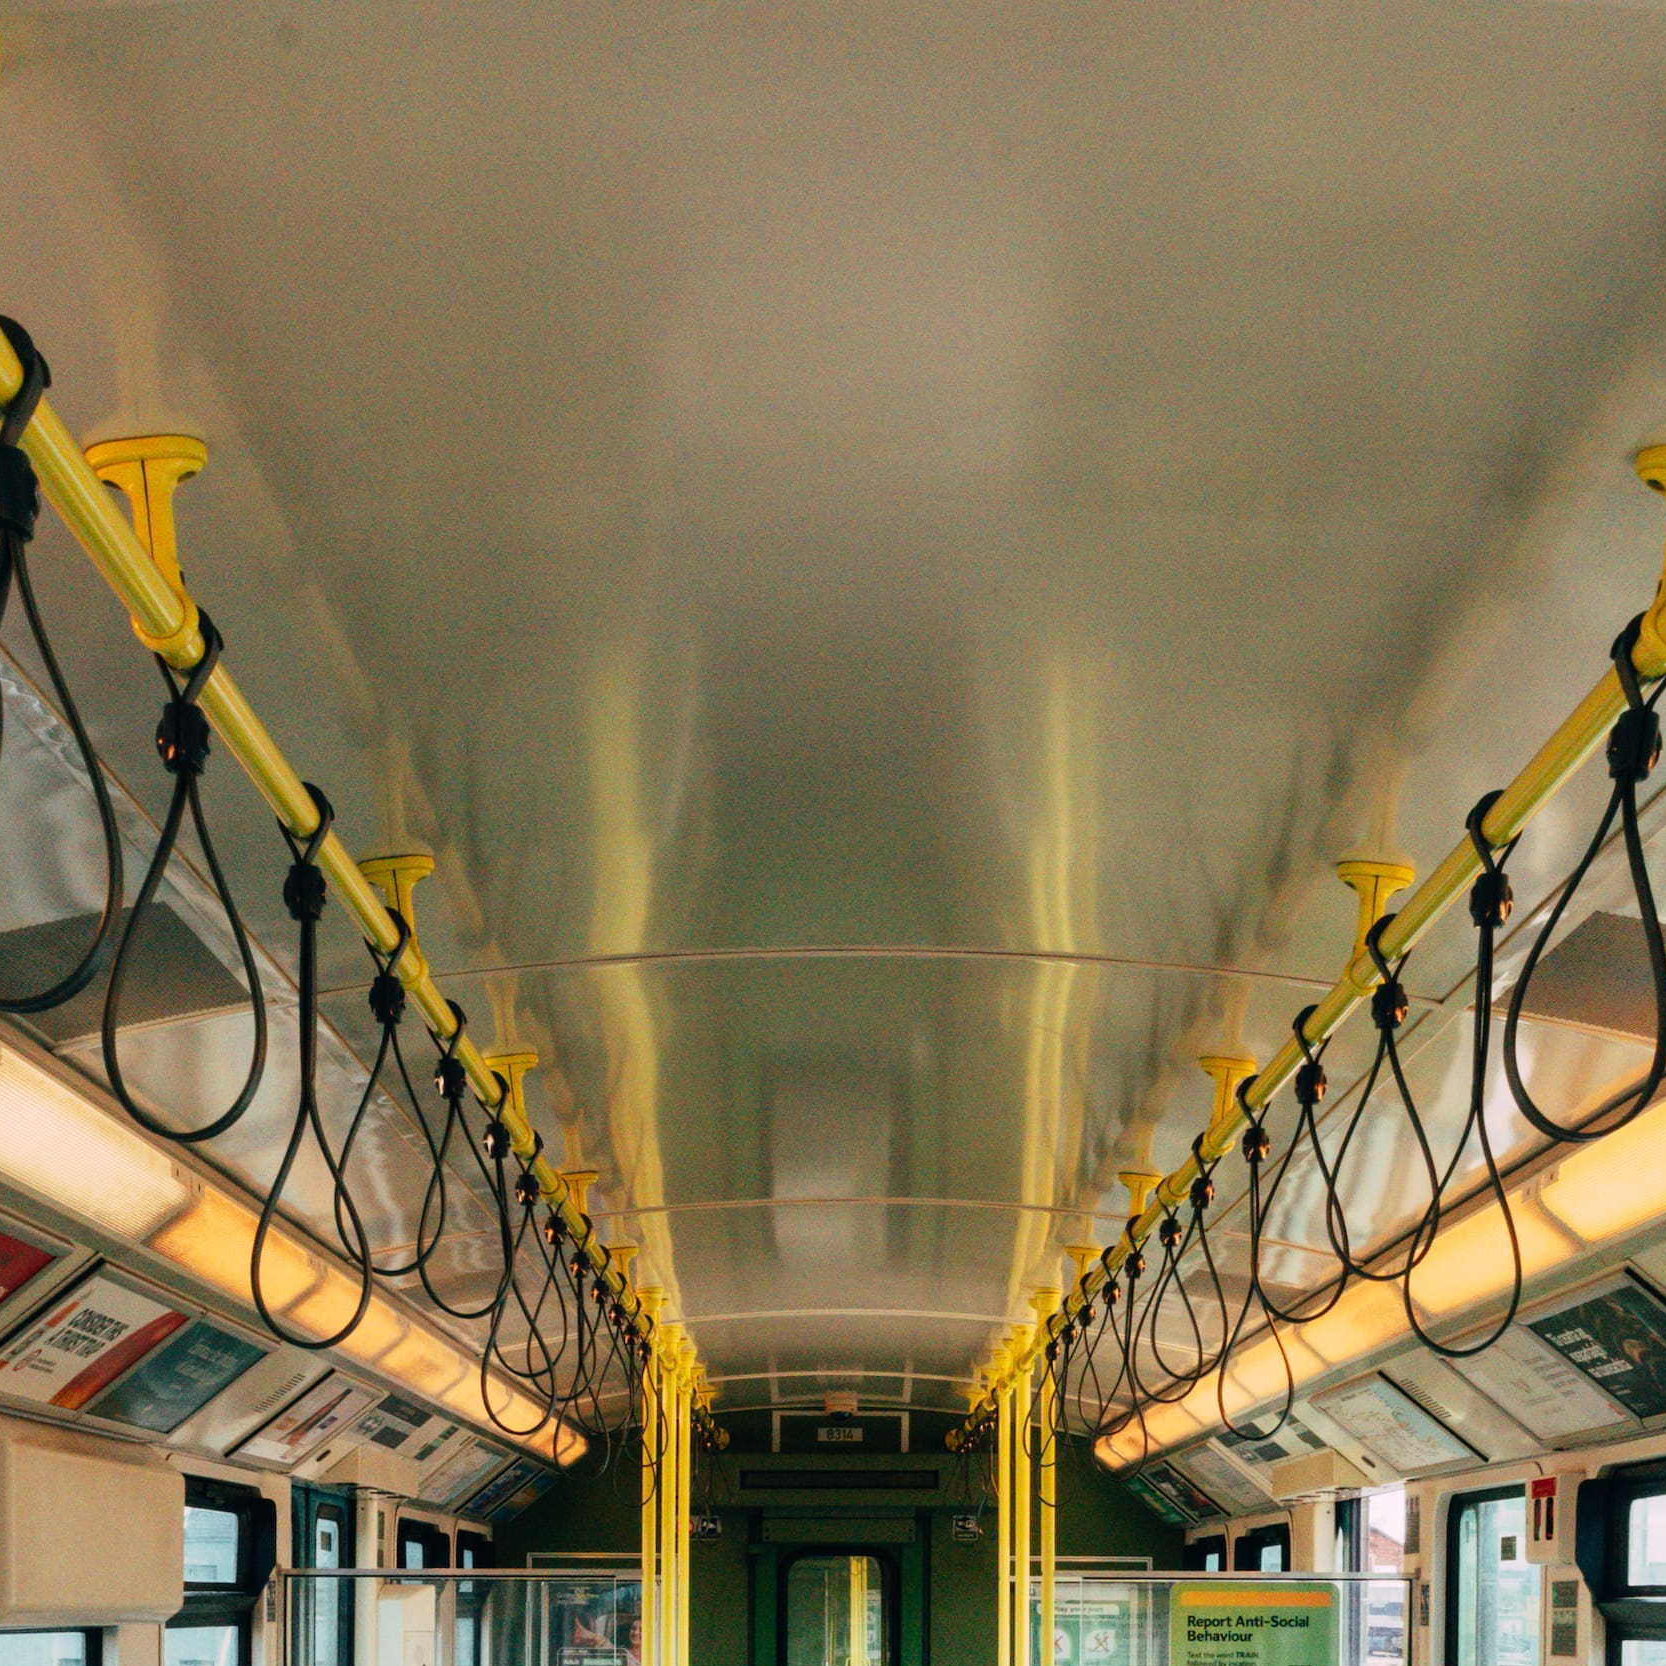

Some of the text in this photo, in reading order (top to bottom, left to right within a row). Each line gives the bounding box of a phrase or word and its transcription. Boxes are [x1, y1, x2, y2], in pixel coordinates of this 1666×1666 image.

[827, 1428, 853, 1439] 8314
[1187, 1616, 1309, 1628] Report Anti-Social
[1187, 1631, 1253, 1642] Behaviour
